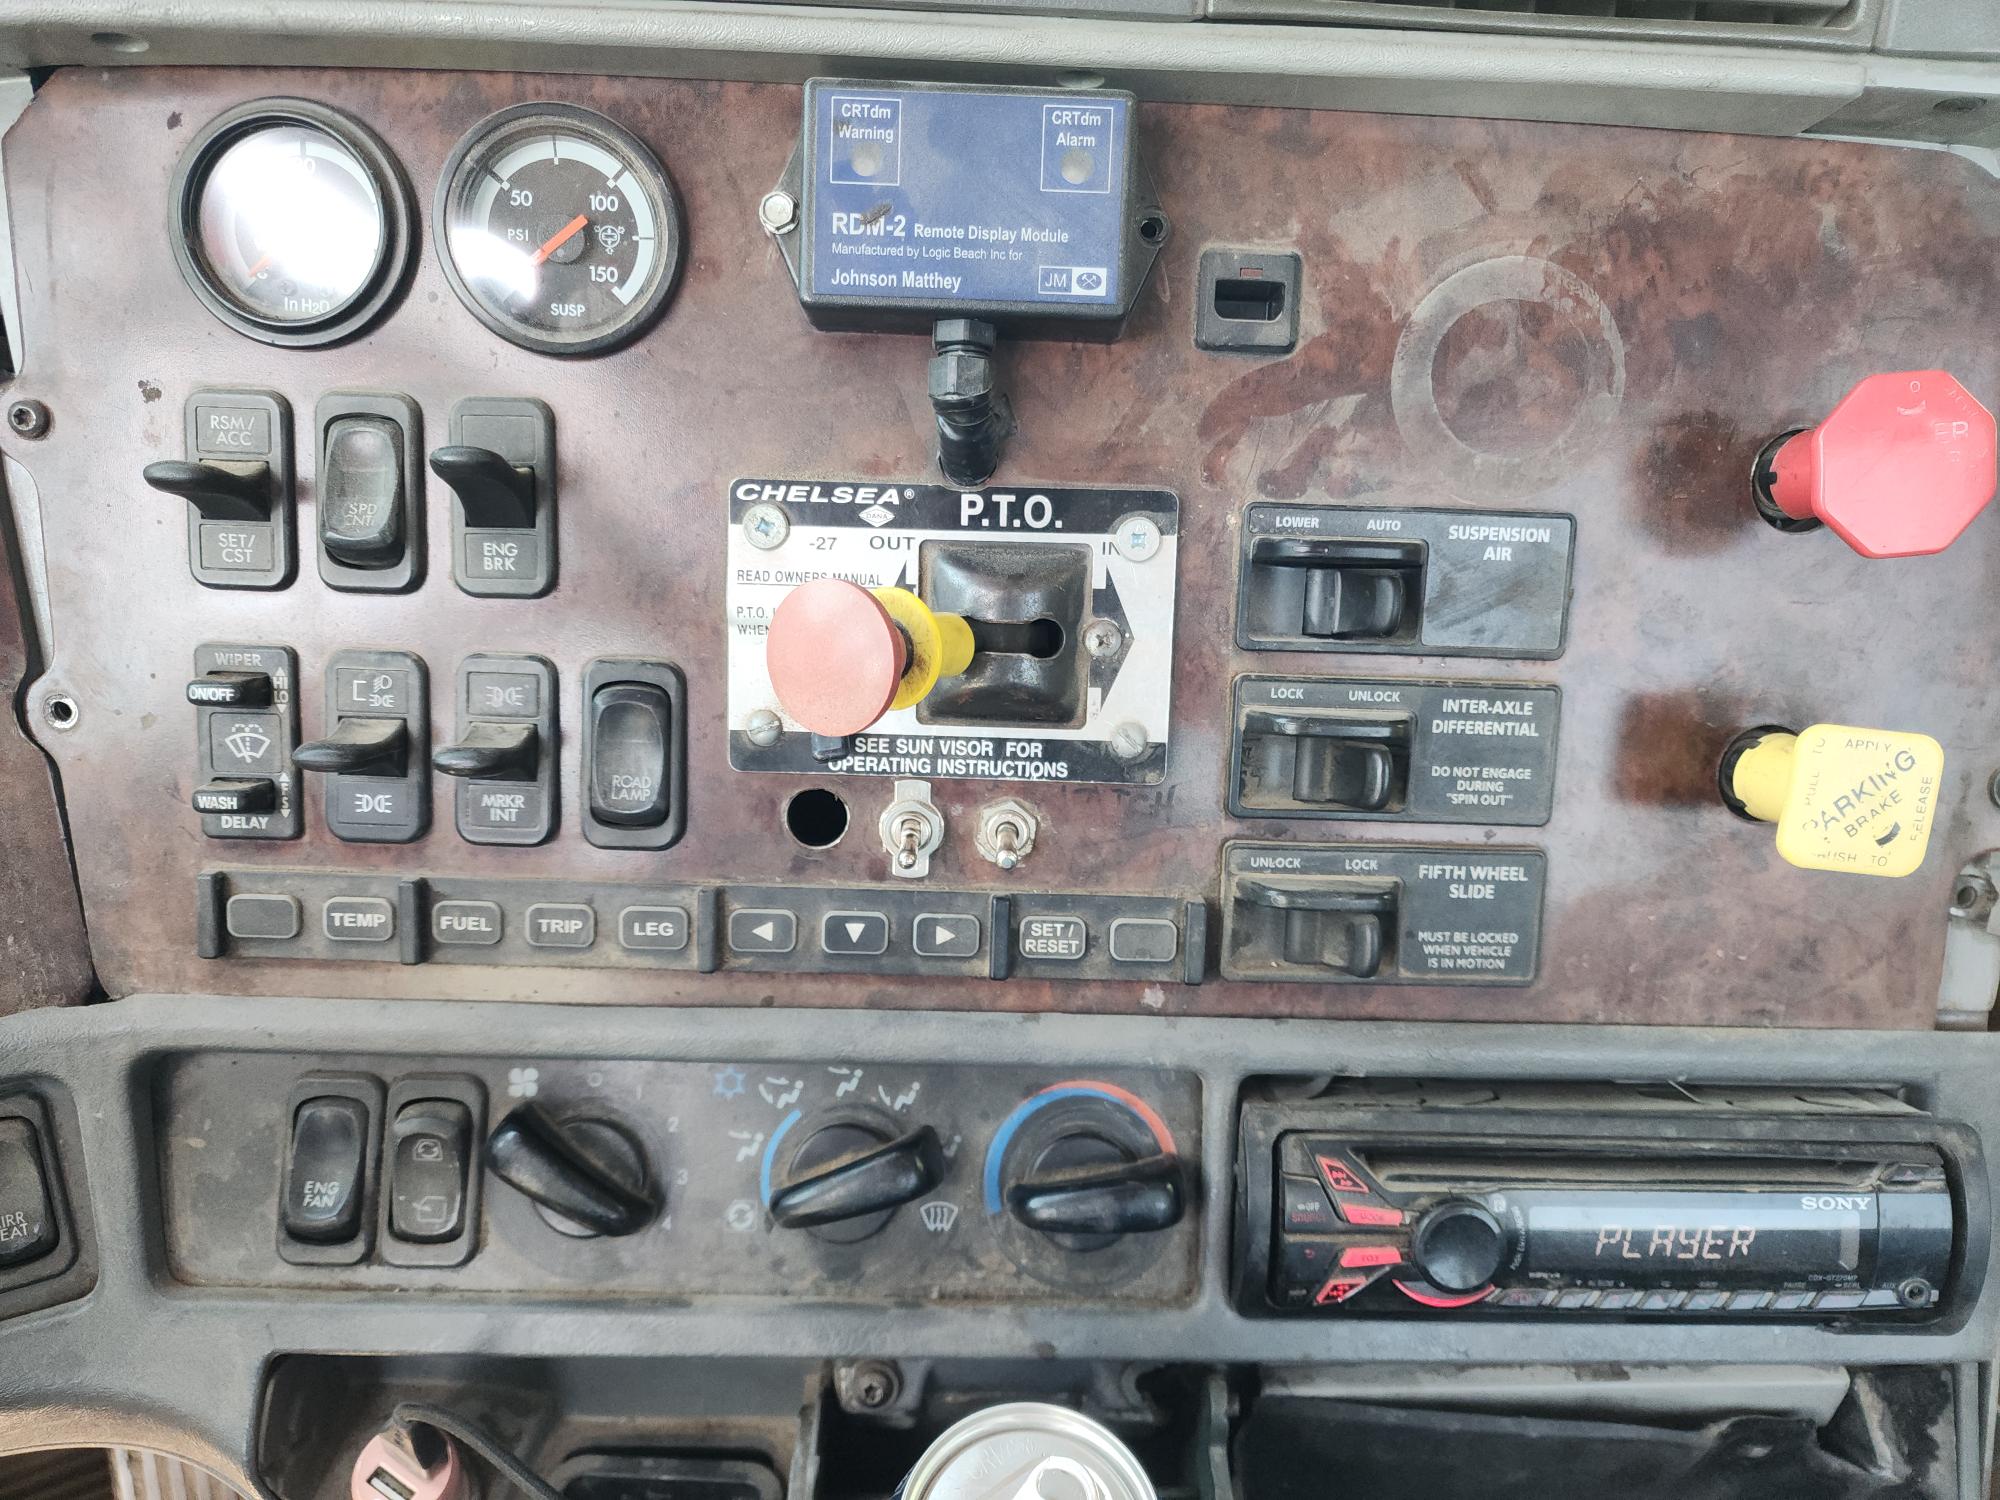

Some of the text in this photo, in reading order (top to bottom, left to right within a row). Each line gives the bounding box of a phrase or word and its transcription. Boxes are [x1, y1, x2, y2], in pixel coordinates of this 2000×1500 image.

[841, 103, 891, 119] CRTdm
[1051, 111, 1101, 127] CRTdm
[839, 125, 894, 145] Warning
[1056, 132, 1096, 148] Alarm
[510, 190, 533, 208] 50
[589, 195, 619, 213] 100
[507, 228, 529, 242] PSI
[832, 212, 1069, 244] RDM-2 Remote Display Module
[832, 241, 1023, 261] Manufactured by Logic Beach Inc for
[589, 265, 618, 283] 150
[831, 268, 962, 293] Johnson Matthey
[1044, 273, 1067, 288] JM
[550, 303, 586, 318] SUSP
[210, 414, 255, 431] RSM/
[216, 431, 252, 447] ACC
[348, 502, 377, 515] SPD
[960, 493, 1063, 529] P.T.O.
[1275, 515, 1320, 529] LOWER
[1366, 519, 1401, 532] AUTO
[218, 532, 256, 548] SET/
[1448, 524, 1551, 544] SUSPENSION
[482, 542, 518, 557] ENG
[869, 535, 916, 551] OUT
[222, 548, 253, 563] CST
[1483, 546, 1513, 562] AIR
[483, 557, 516, 572] BRK
[737, 569, 771, 582] READ
[214, 652, 262, 667] WIPER
[272, 676, 289, 690] HI
[188, 687, 235, 701] ON/OFF
[273, 690, 289, 703] LO
[1270, 687, 1304, 700] LOCK
[1348, 690, 1401, 703] UNLOCK
[1442, 698, 1534, 716] INTER-AXLE
[1431, 719, 1539, 738] DIFFERENTIAL
[854, 737, 1043, 759] SEE SUN VISOR FOR
[937, 759, 1069, 778] INSTRUCTIONS
[1431, 765, 1532, 780] DO NOT ENGAGE
[611, 775, 652, 788] ROAD
[1456, 780, 1504, 792] DURING
[197, 795, 238, 810] WASH
[481, 794, 525, 809] MRKR
[611, 787, 651, 802] LAMP
[489, 808, 520, 822] INT
[1843, 789, 1903, 838] BRAKE
[221, 816, 270, 830] DELAY
[1250, 856, 1301, 869] UNLOCK
[1345, 859, 1379, 871] LOCK
[1418, 864, 1528, 882] FIFTH WHEEL
[1449, 883, 1496, 900] SLIDE
[330, 912, 387, 928] TEMP
[440, 915, 493, 933] FUEL
[537, 918, 584, 935] TRIP
[632, 921, 674, 937] LEG
[1418, 931, 1519, 944] MUST BE LOCKED
[1025, 938, 1079, 955] RESET
[1423, 944, 1512, 957] WHEN VEHICLE
[1427, 957, 1506, 970] IS IN MOTION
[667, 1116, 679, 1133] 2
[677, 1168, 689, 1186] 3
[304, 1180, 340, 1196] ENG
[303, 1193, 336, 1208] FAN
[1801, 1196, 1871, 1211] SONY
[0, 1211, 26, 1229] IRR
[1595, 1224, 1756, 1260] PLAYER
